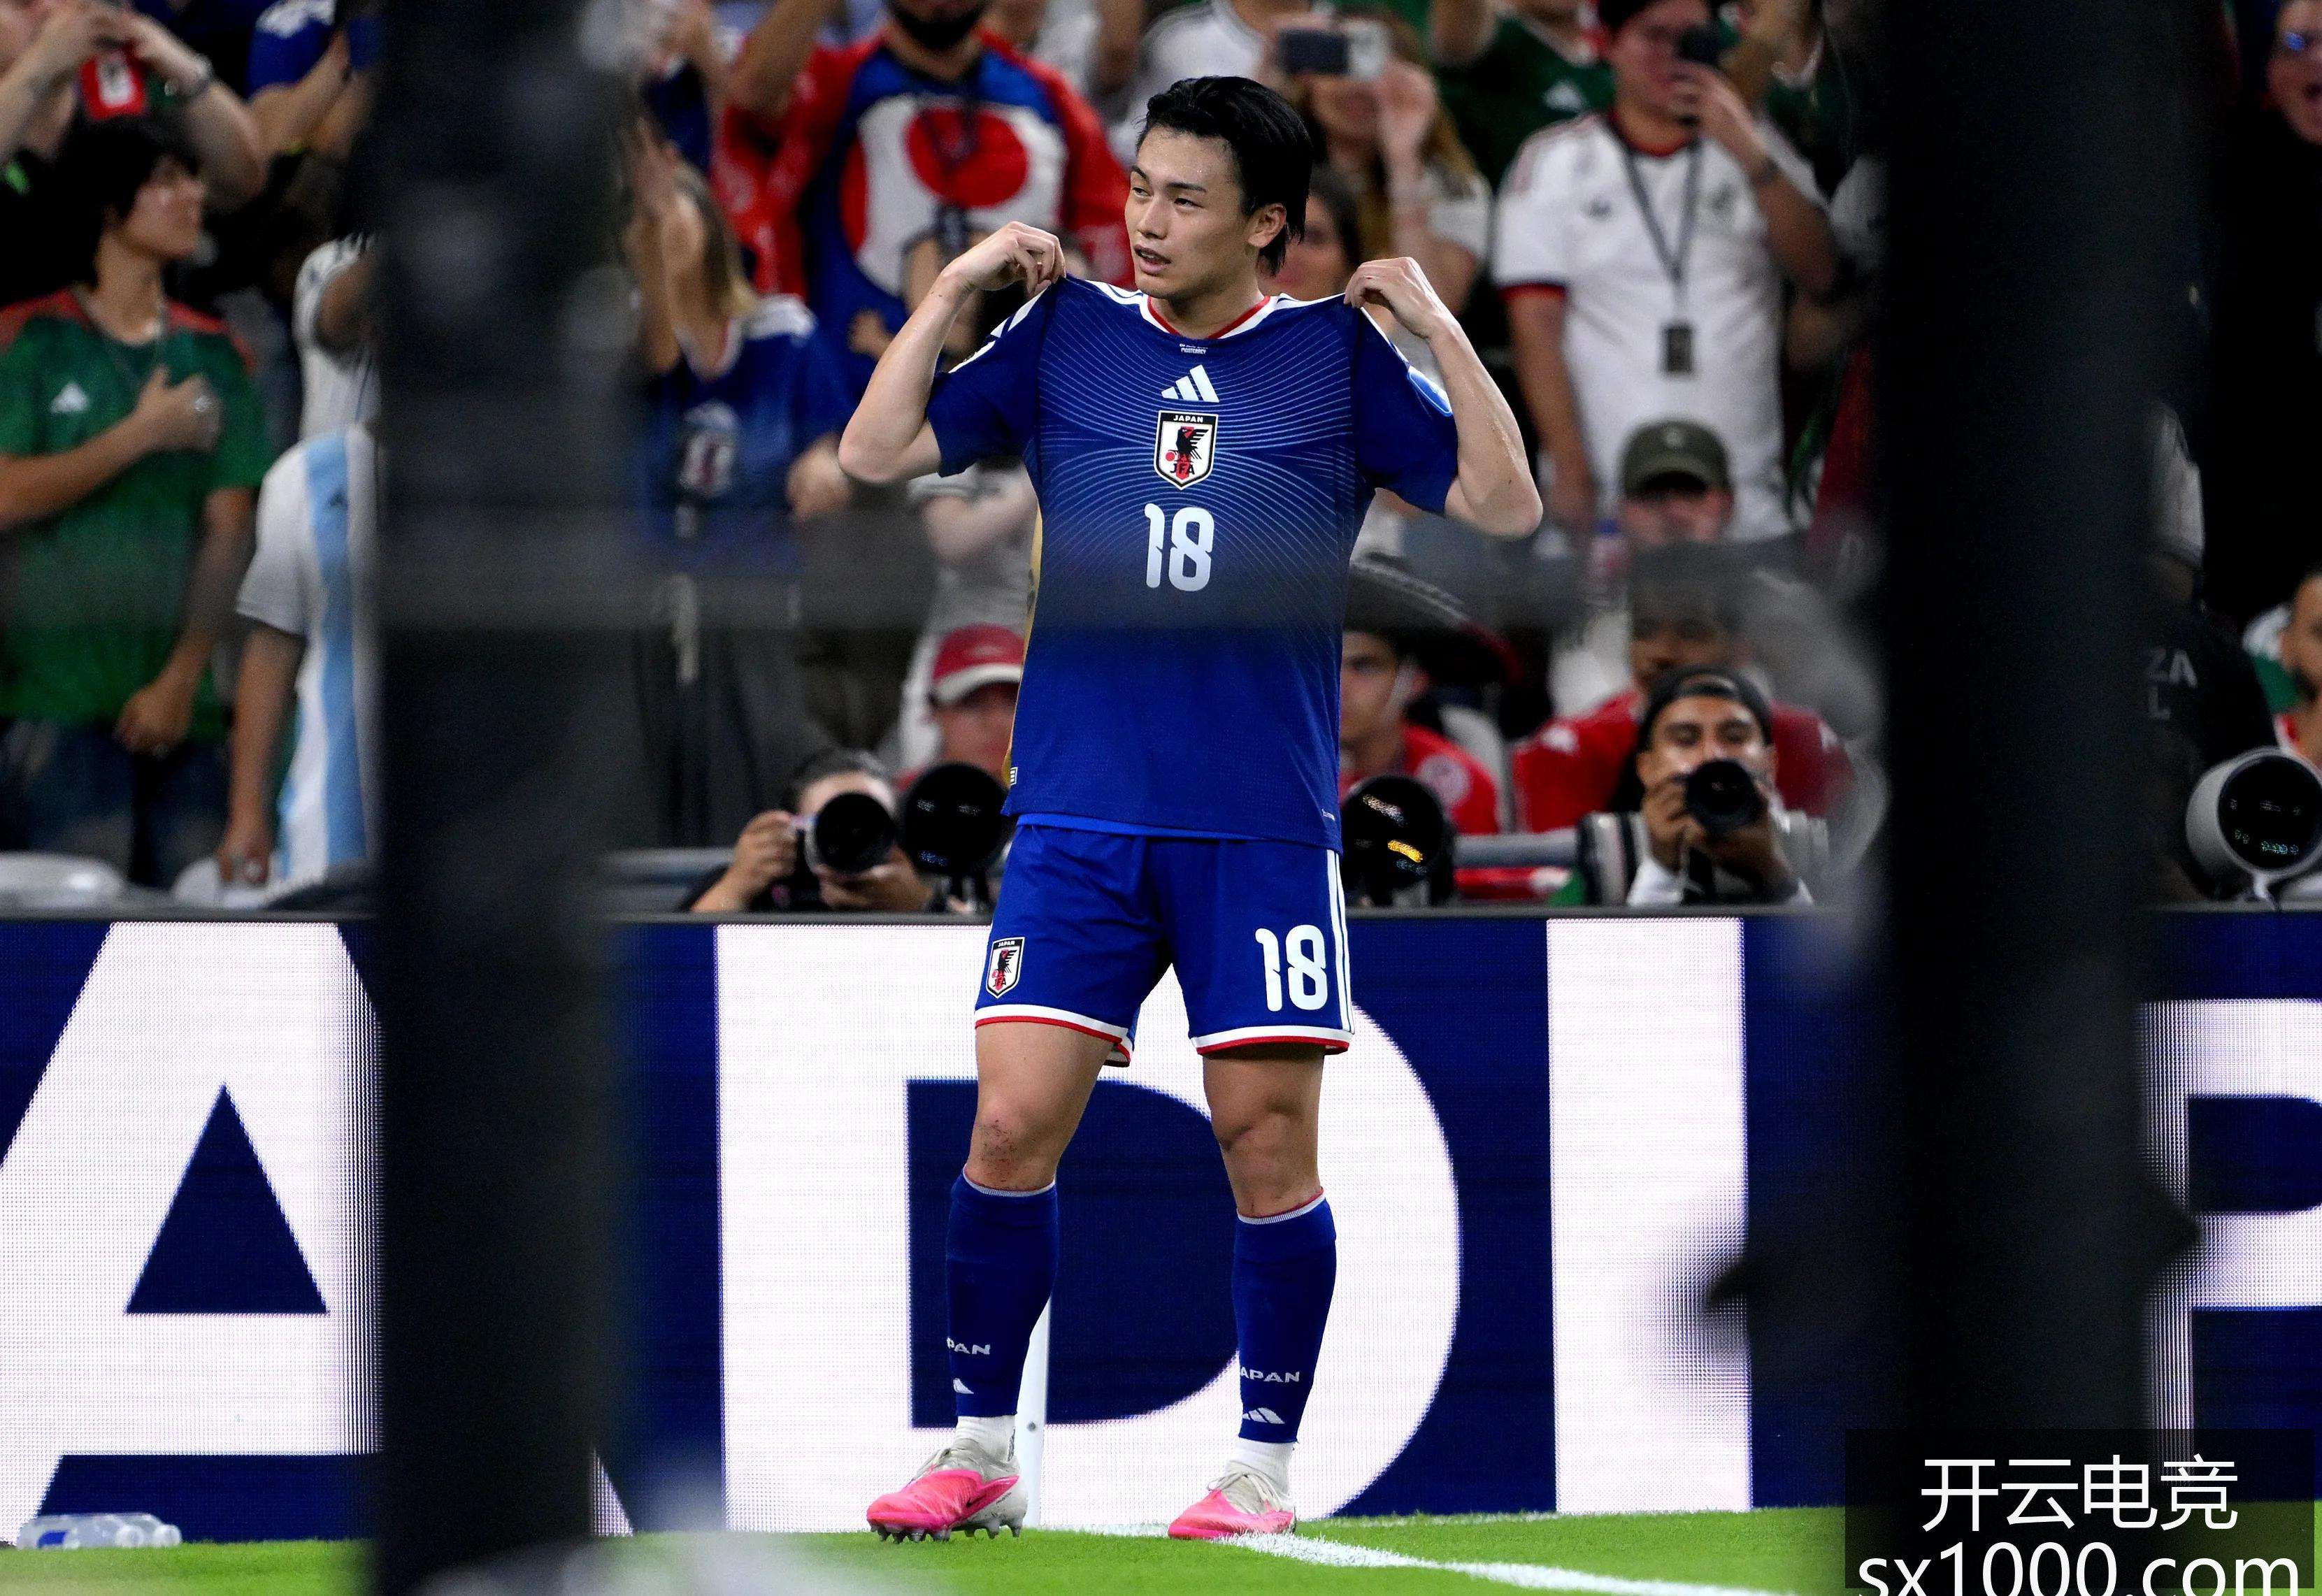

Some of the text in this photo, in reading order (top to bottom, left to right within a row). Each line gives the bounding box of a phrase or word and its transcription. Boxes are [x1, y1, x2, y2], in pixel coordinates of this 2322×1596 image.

[1173, 415, 1203, 424] JAPAN
[1170, 463, 1196, 475] JFA
[1144, 503, 1215, 592] 18
[1254, 923, 1328, 1012] 18
